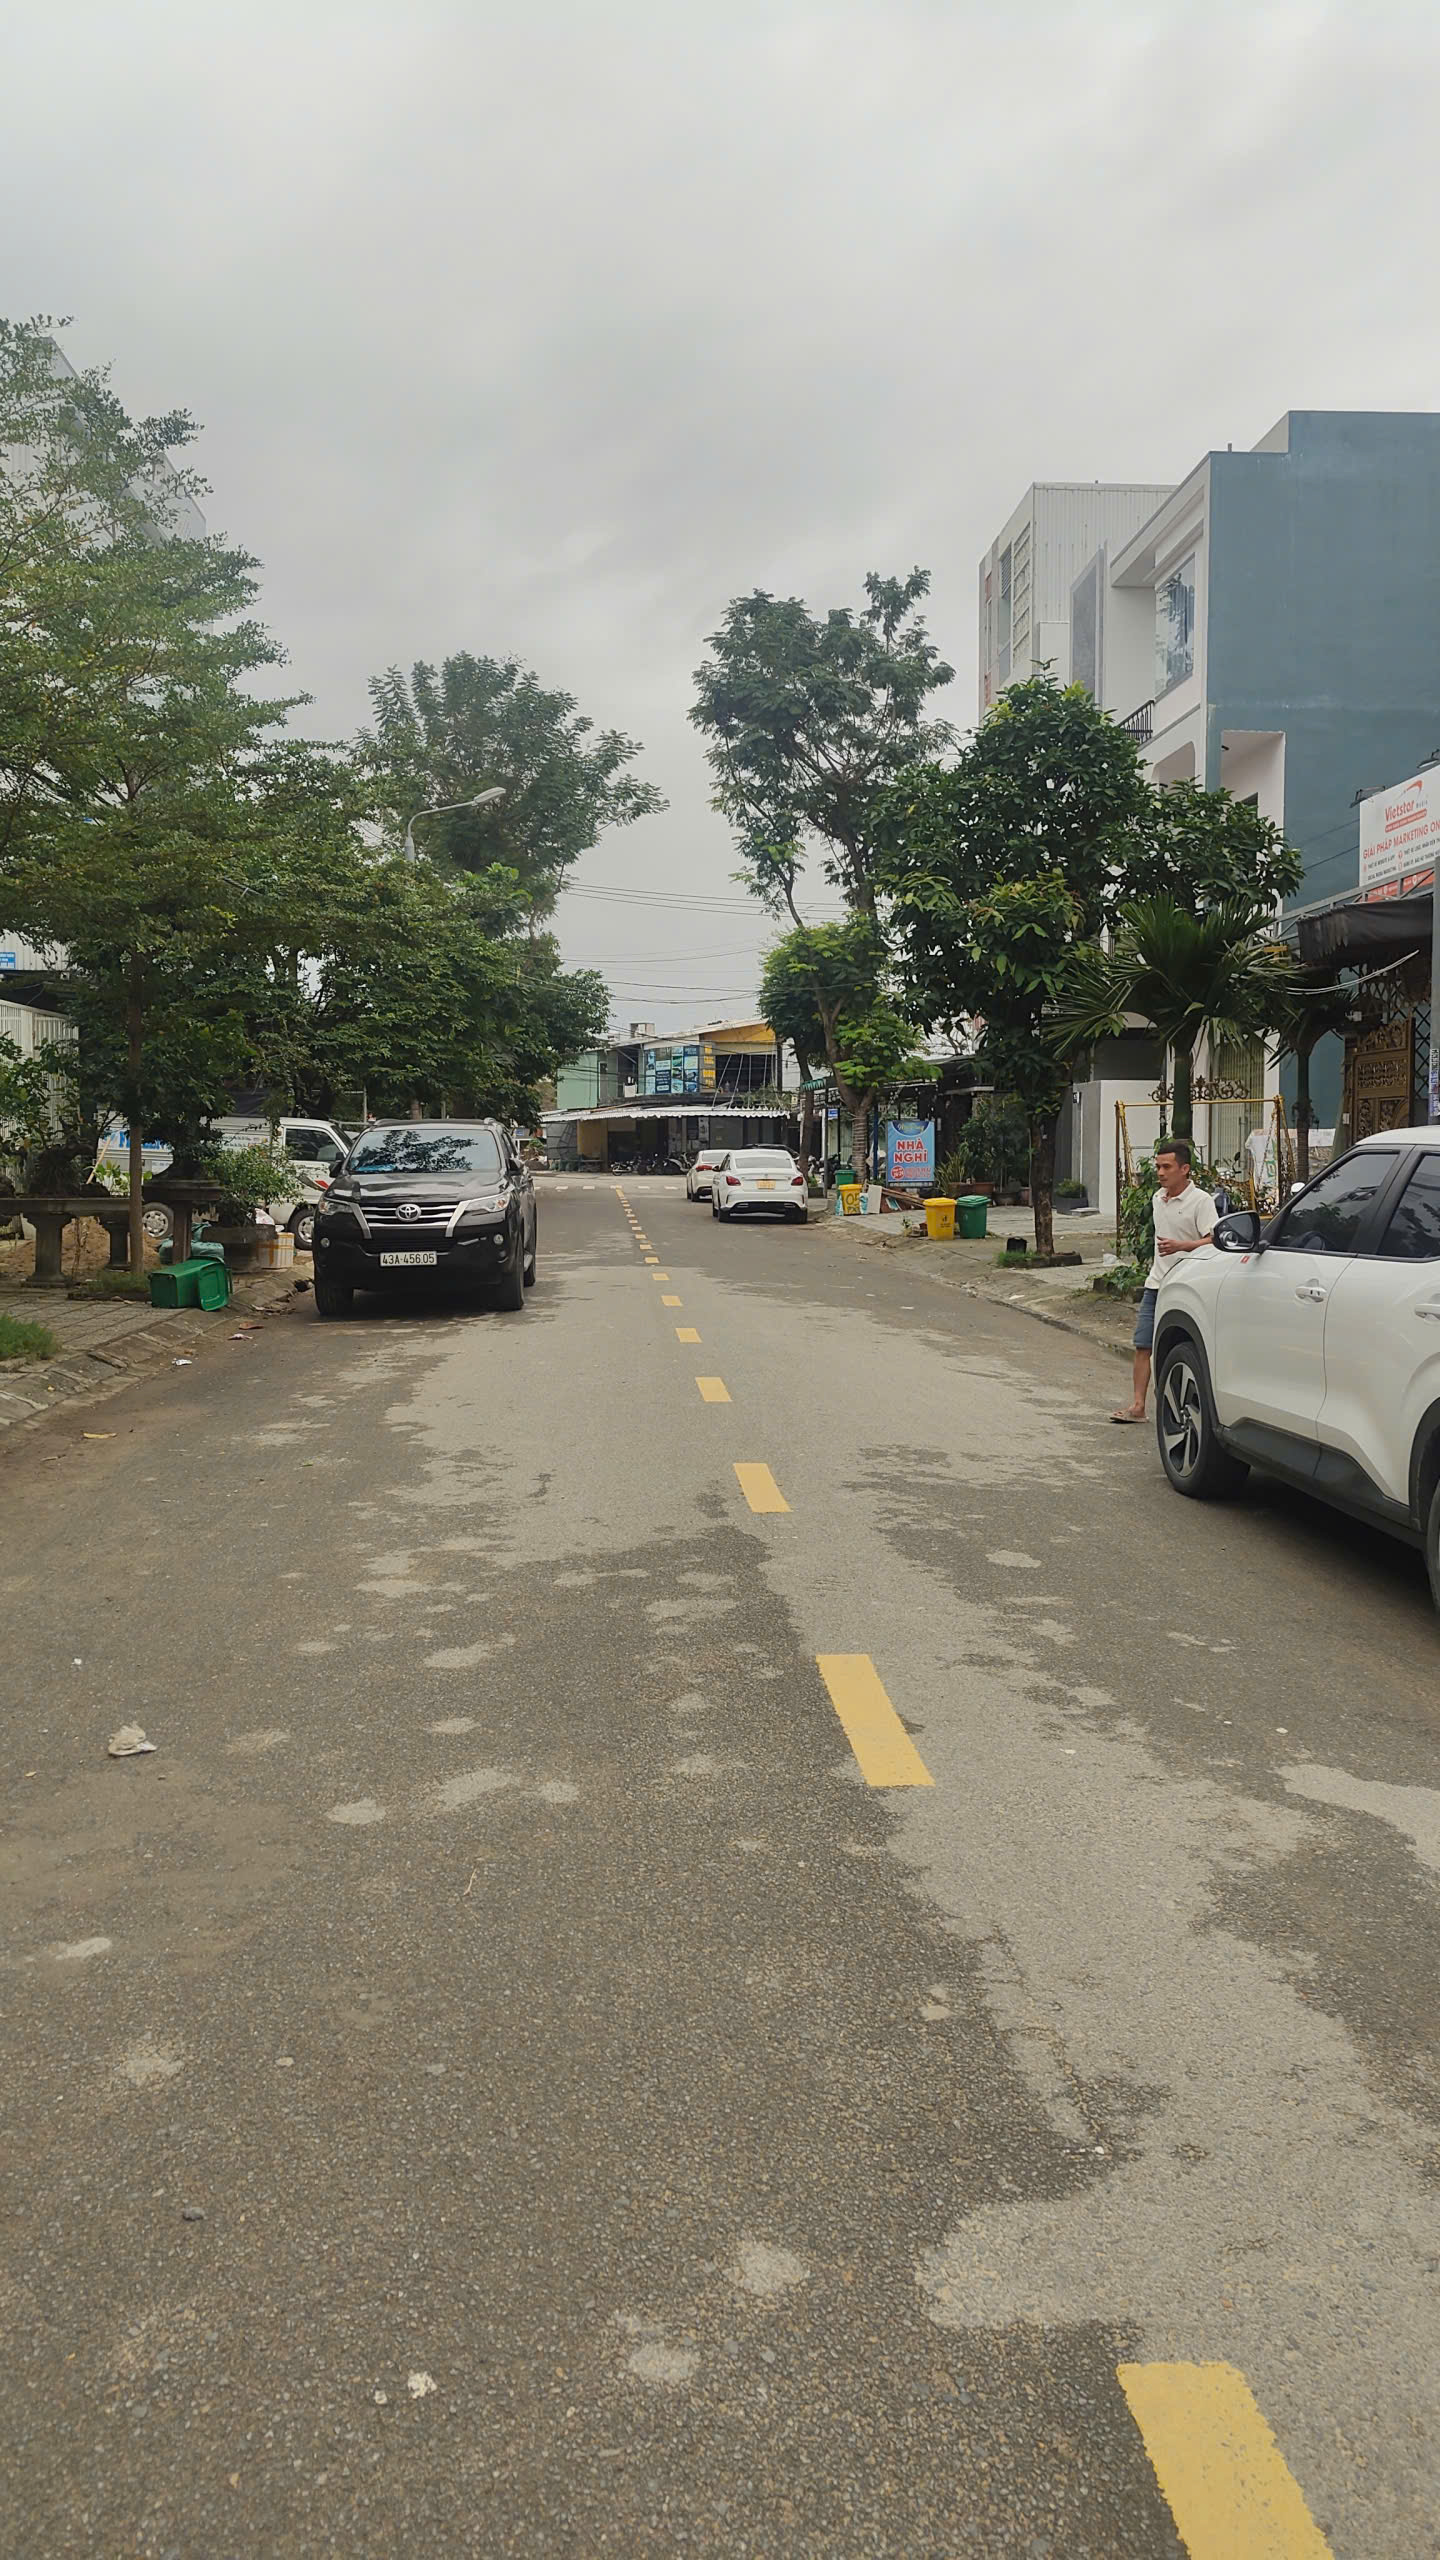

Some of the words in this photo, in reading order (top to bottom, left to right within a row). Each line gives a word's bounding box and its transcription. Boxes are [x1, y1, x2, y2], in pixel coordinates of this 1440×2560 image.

[1385, 800, 1414, 821] Vietstar
[1394, 824, 1429, 847] MARKETING
[896, 1137, 925, 1151] NHÀ
[382, 1253, 435, 1265] 43A-456.05
